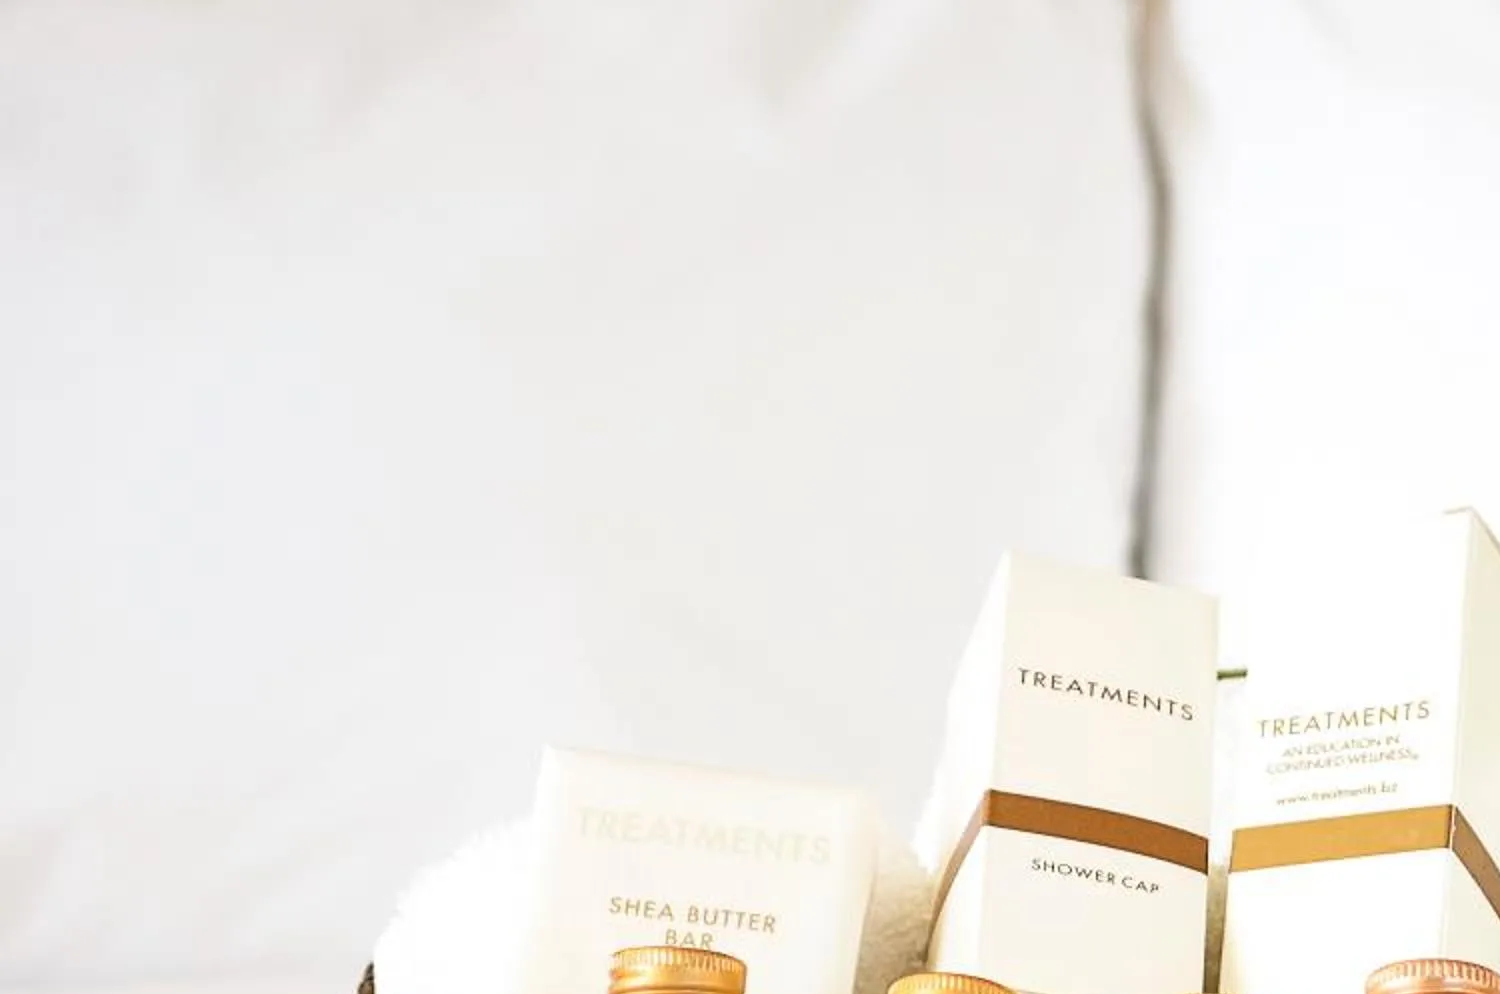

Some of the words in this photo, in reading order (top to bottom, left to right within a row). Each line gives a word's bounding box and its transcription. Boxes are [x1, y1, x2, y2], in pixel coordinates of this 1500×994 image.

[1017, 666, 1194, 721] TREATMENTS
[1257, 699, 1431, 738] TREATMENTS
[577, 805, 832, 865] TREATMENTS
[1031, 857, 1116, 885] SHOWER
[1121, 875, 1161, 894] CAP
[608, 896, 675, 922] SHEA
[686, 905, 777, 934] BUTTER
[664, 928, 715, 949] BAR
